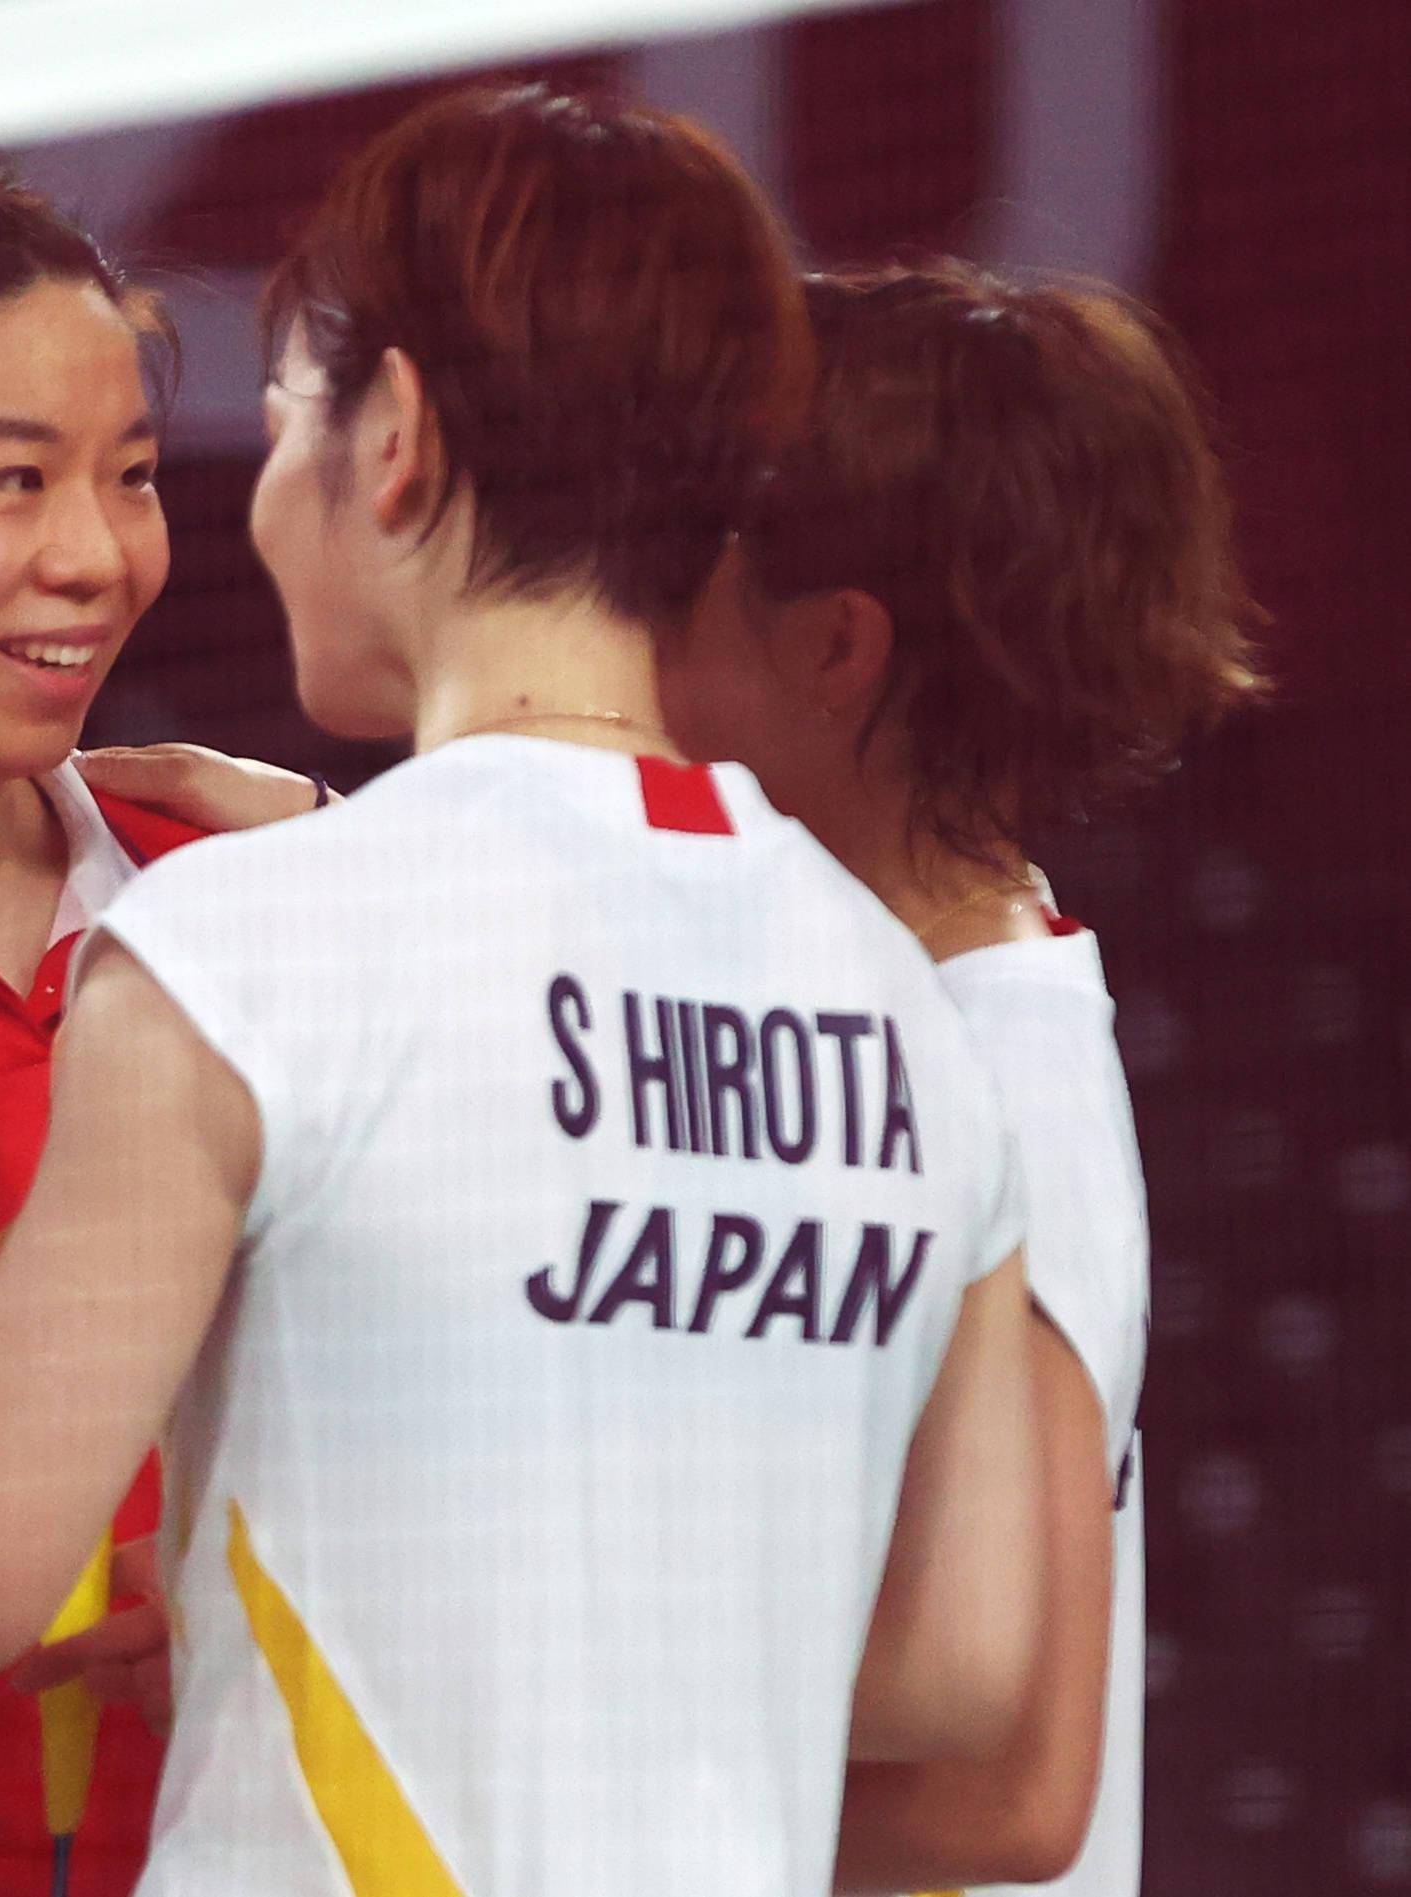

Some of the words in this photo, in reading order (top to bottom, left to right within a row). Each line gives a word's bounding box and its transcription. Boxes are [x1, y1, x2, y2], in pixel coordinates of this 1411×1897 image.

[547, 973, 601, 1140] S
[622, 990, 921, 1175] HIROTA
[524, 1199, 935, 1348] JAPAN
